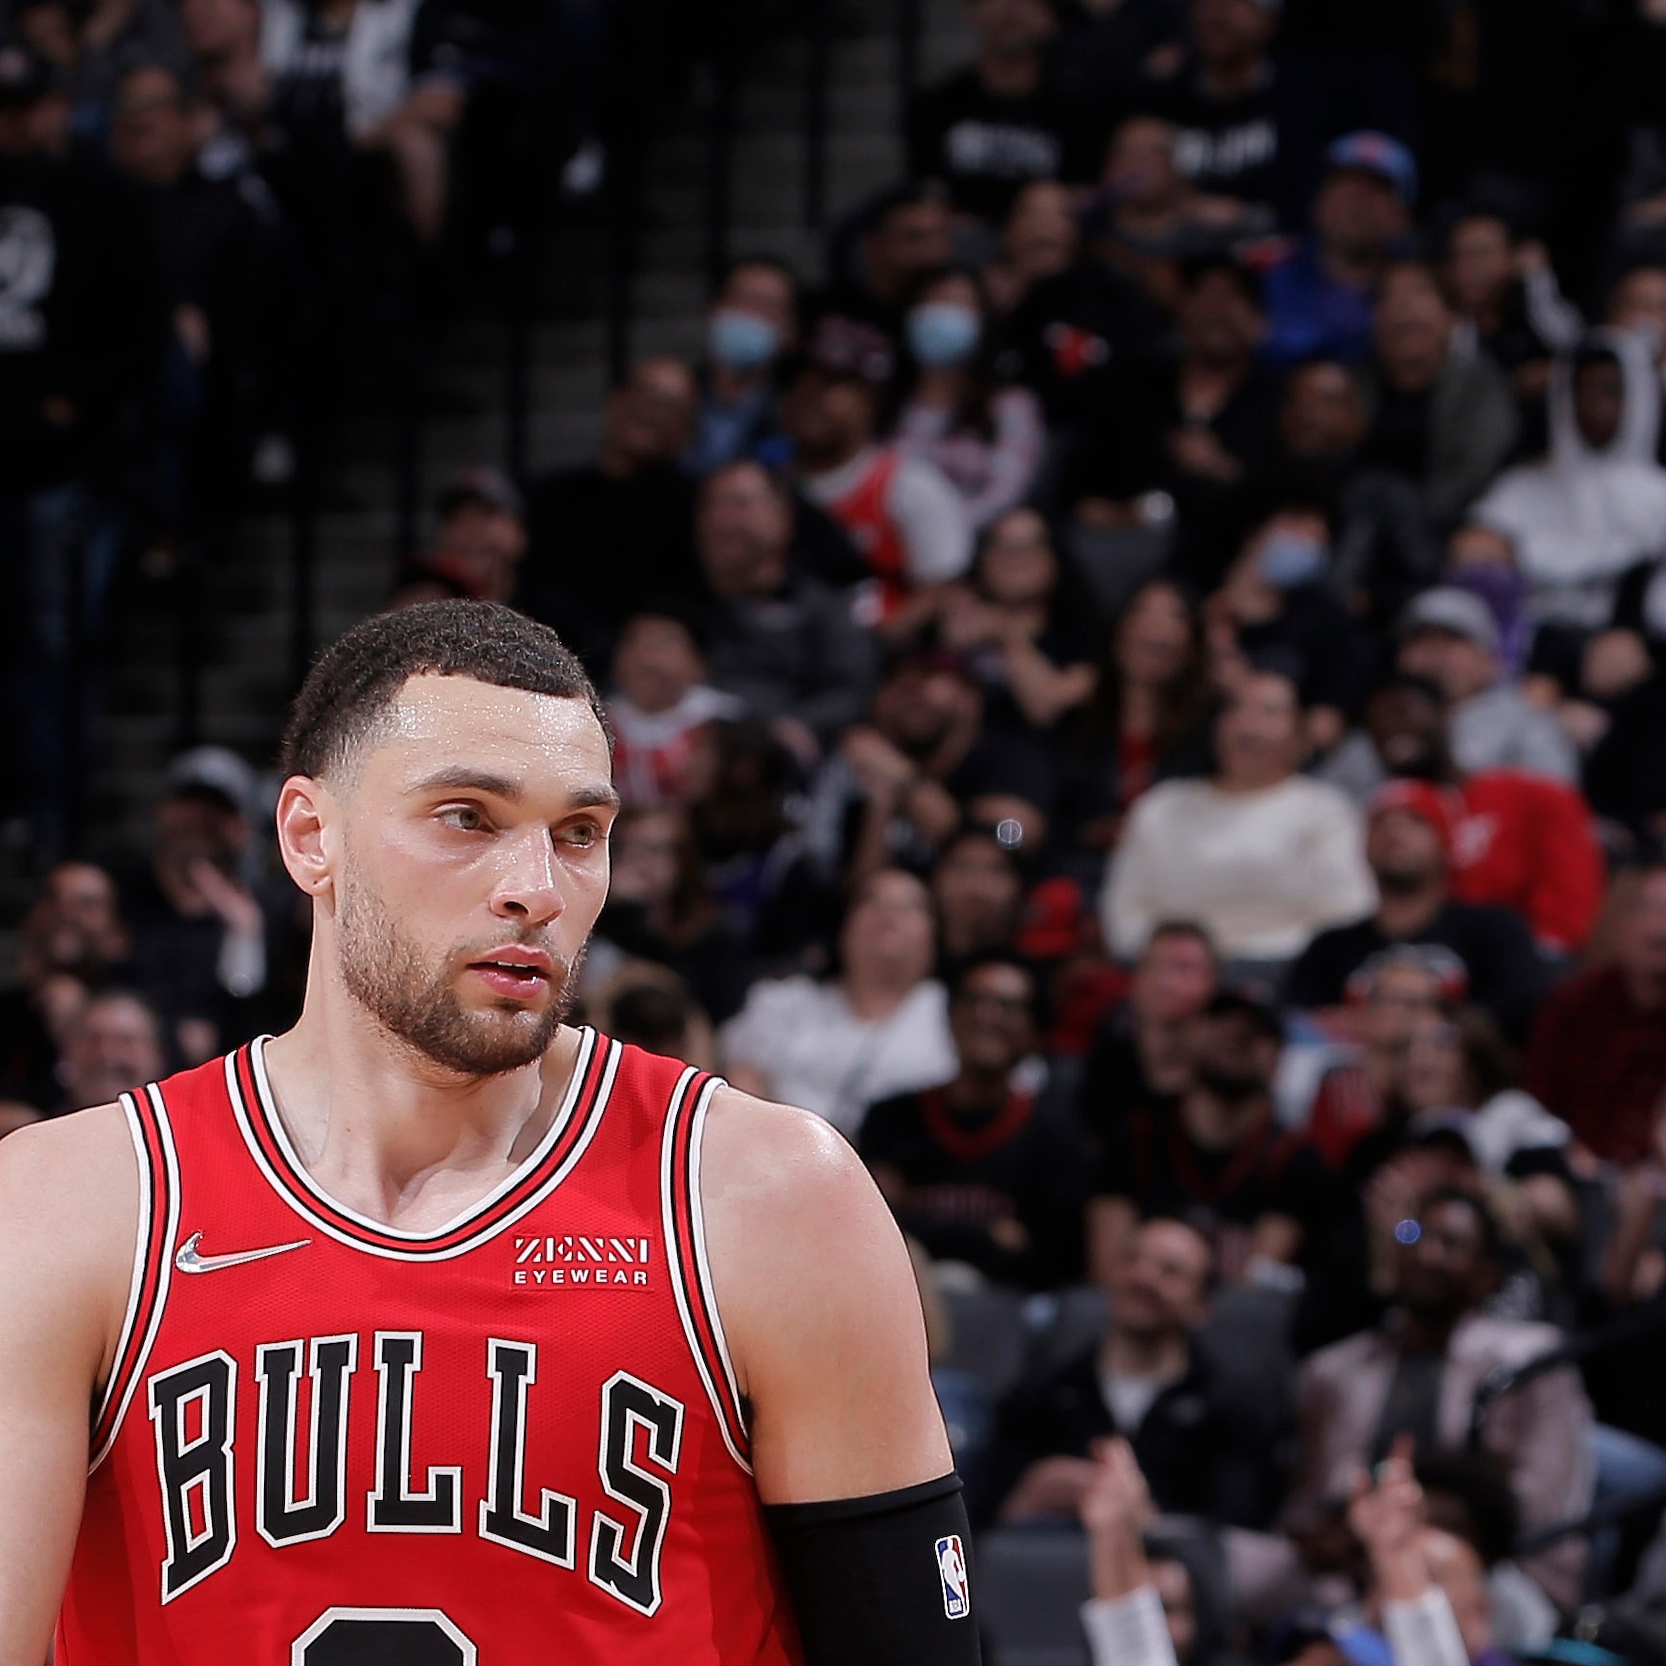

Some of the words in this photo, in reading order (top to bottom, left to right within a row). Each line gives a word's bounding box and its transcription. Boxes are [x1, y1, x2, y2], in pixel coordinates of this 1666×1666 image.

[513, 1236, 650, 1265] ZENNI
[513, 1270, 650, 1286] EYEWEAR
[147, 1330, 686, 1618] BULLS
